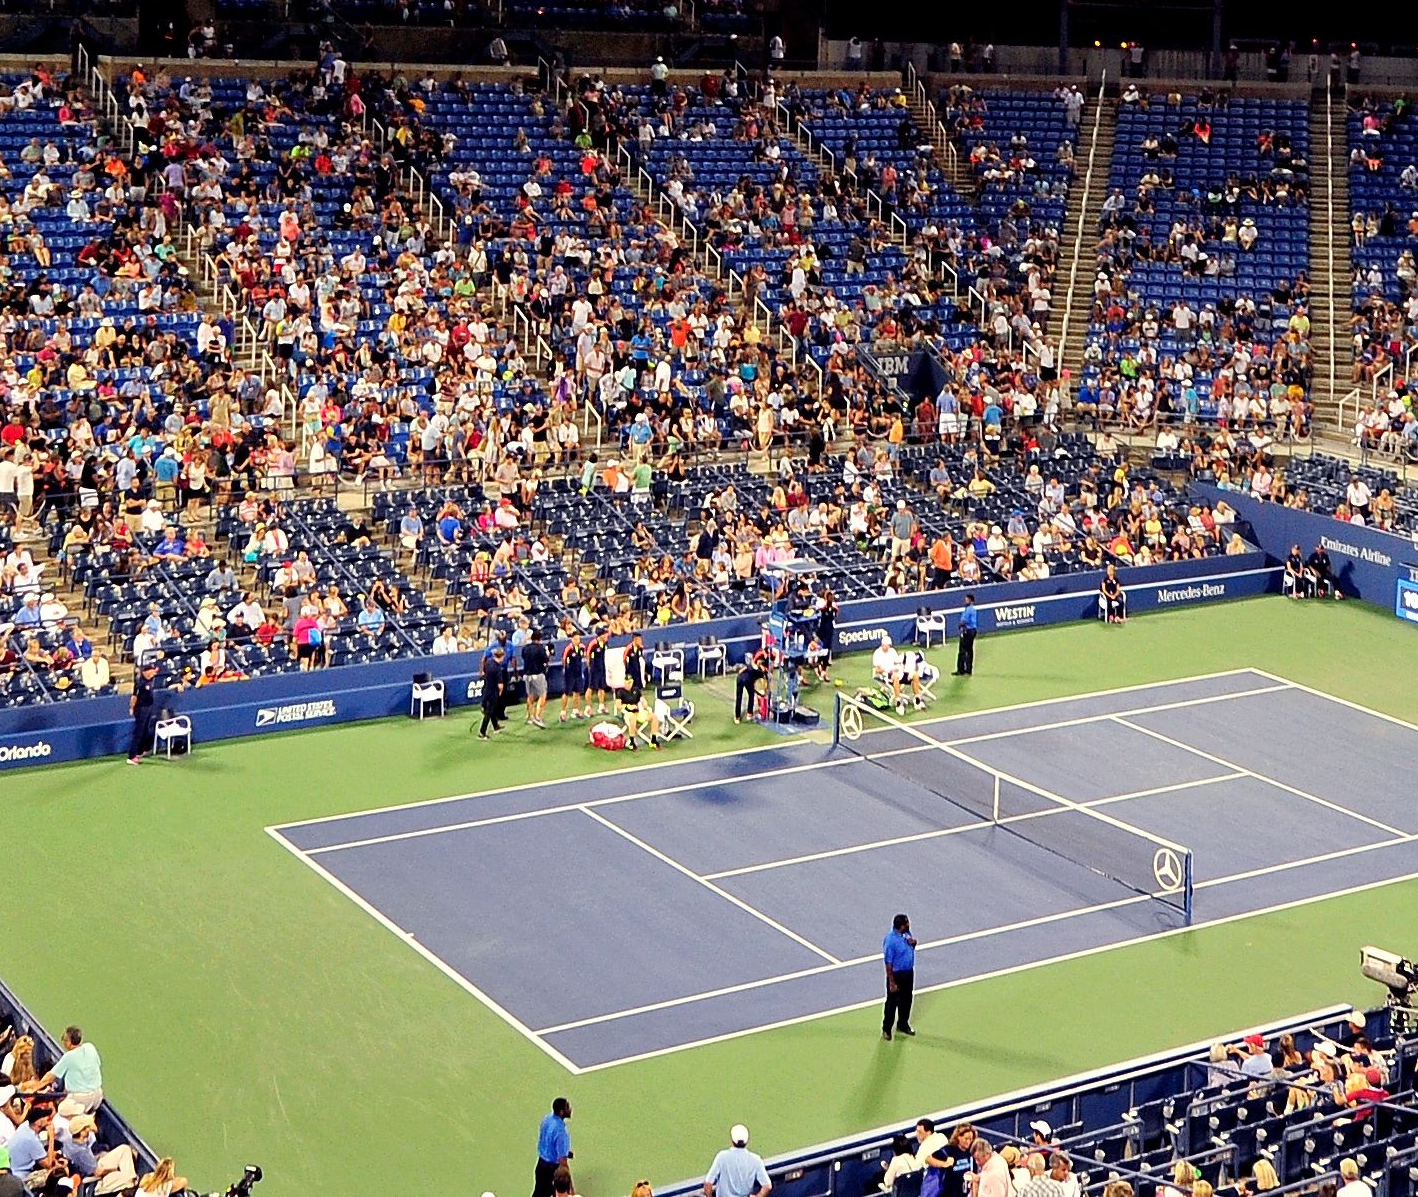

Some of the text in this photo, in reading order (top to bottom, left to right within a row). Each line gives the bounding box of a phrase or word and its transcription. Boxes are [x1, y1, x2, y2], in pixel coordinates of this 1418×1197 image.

[877, 355, 909, 375] IBM
[1321, 536, 1392, 567] Emirates Airline
[1157, 583, 1225, 603] Mercedes-Benz
[994, 605, 1036, 622] WESTIN
